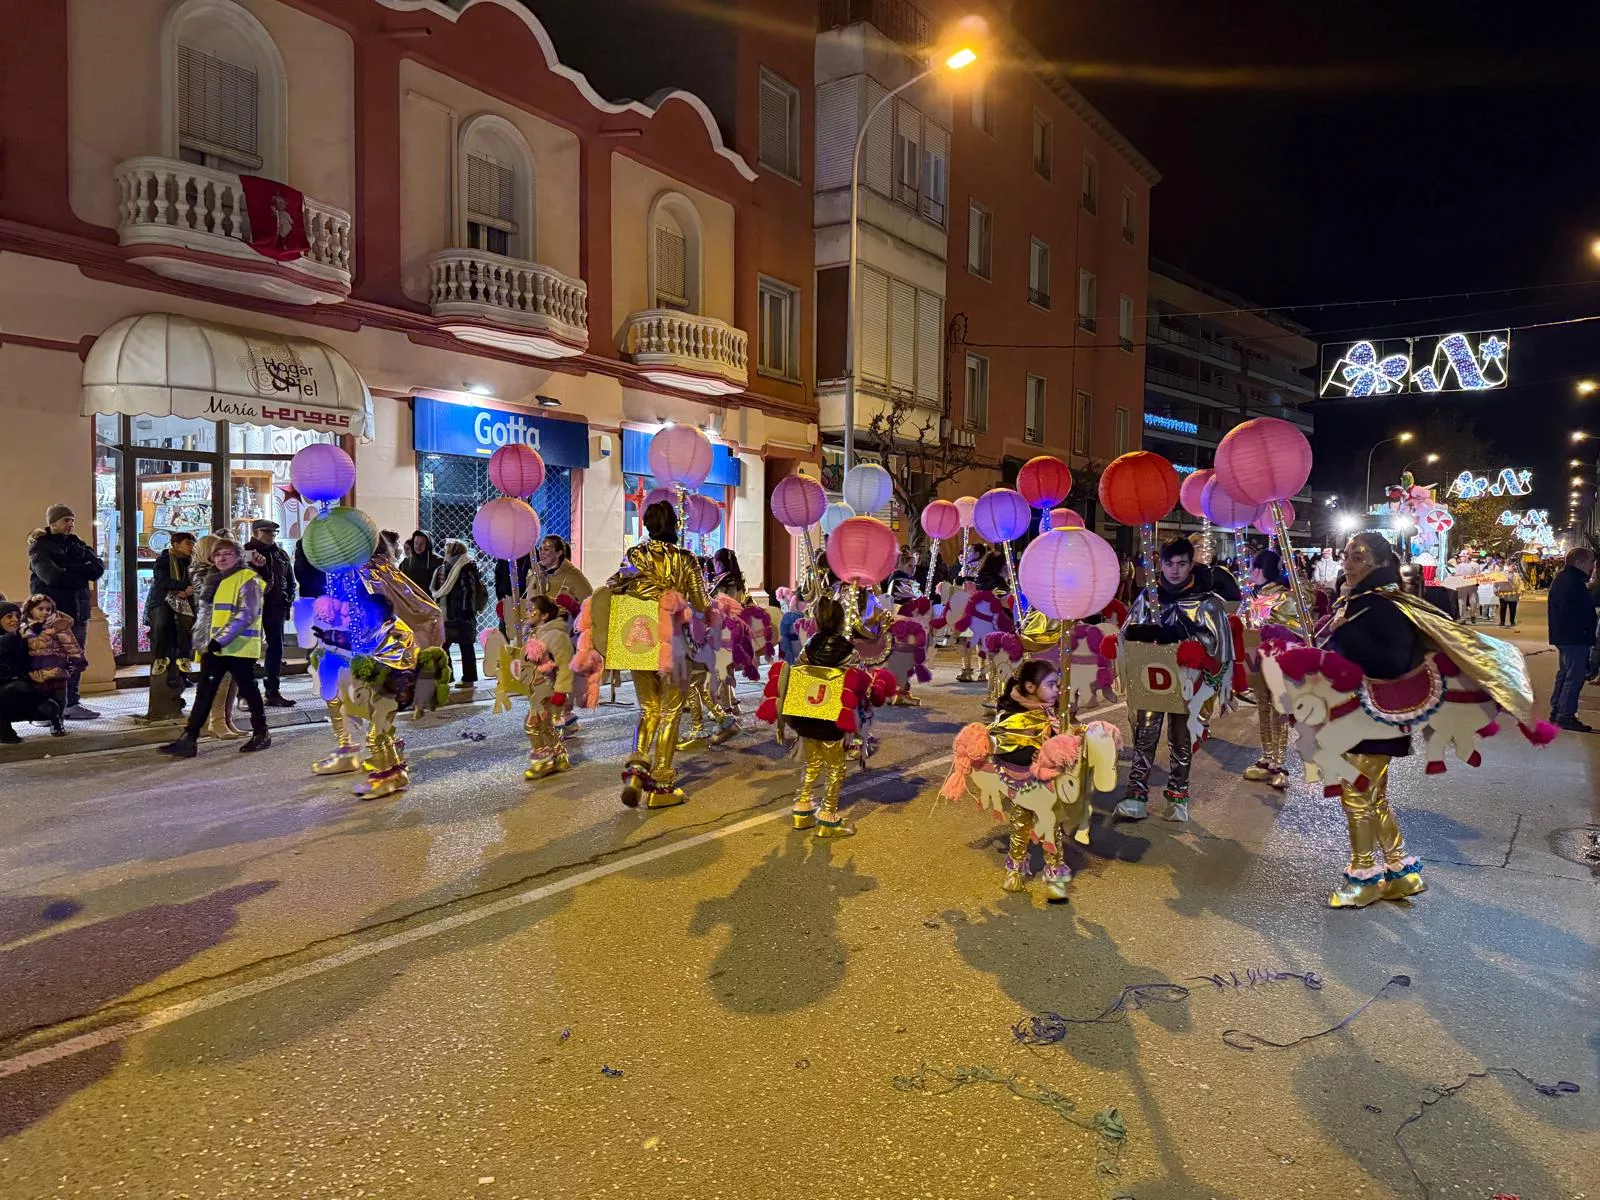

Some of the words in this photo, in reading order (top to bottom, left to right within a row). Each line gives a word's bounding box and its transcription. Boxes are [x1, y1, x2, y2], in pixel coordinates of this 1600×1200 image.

[263, 357, 314, 378] Hogar
[286, 376, 318, 397] Piel
[203, 395, 257, 417] María
[474, 411, 541, 451] Gotta
[625, 615, 656, 647] A
[1147, 666, 1172, 691] D
[807, 684, 827, 705] J
